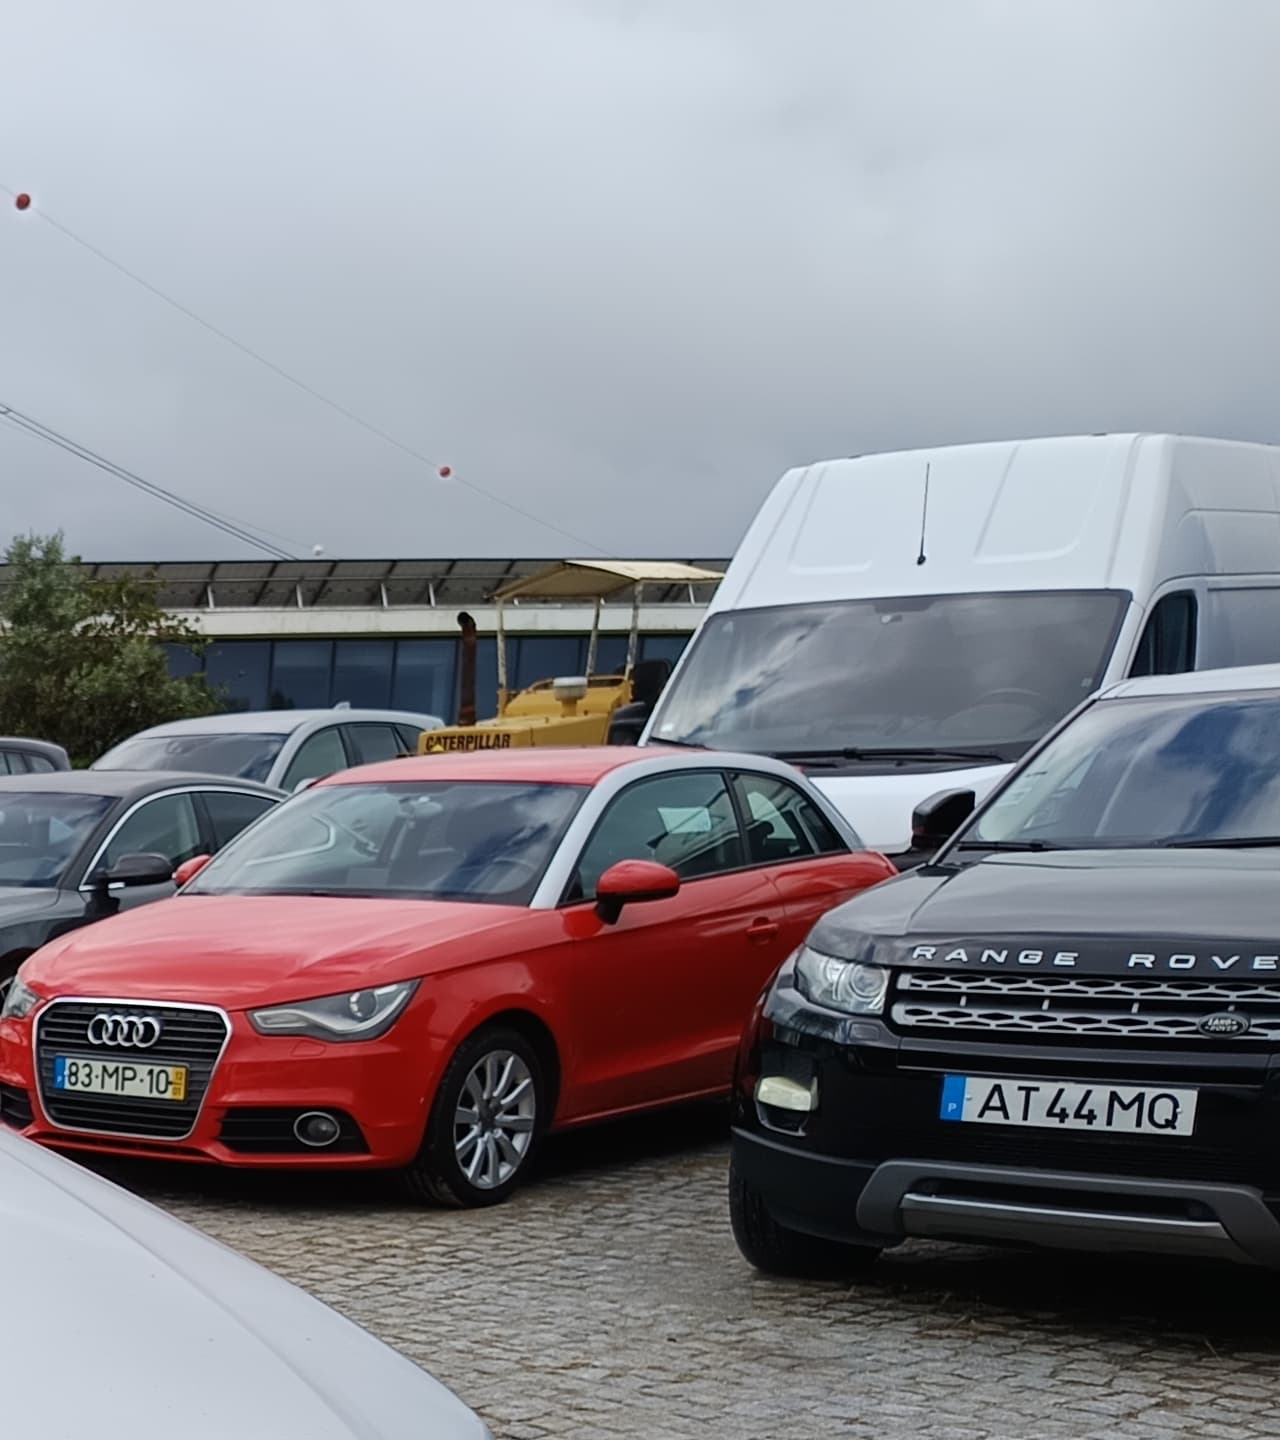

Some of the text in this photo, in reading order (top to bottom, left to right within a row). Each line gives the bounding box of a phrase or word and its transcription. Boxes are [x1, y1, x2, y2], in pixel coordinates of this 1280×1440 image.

[425, 733, 511, 752] CATERPILLAR
[911, 946, 1279, 971] RANGE ROVE
[947, 1102, 958, 1113] P
